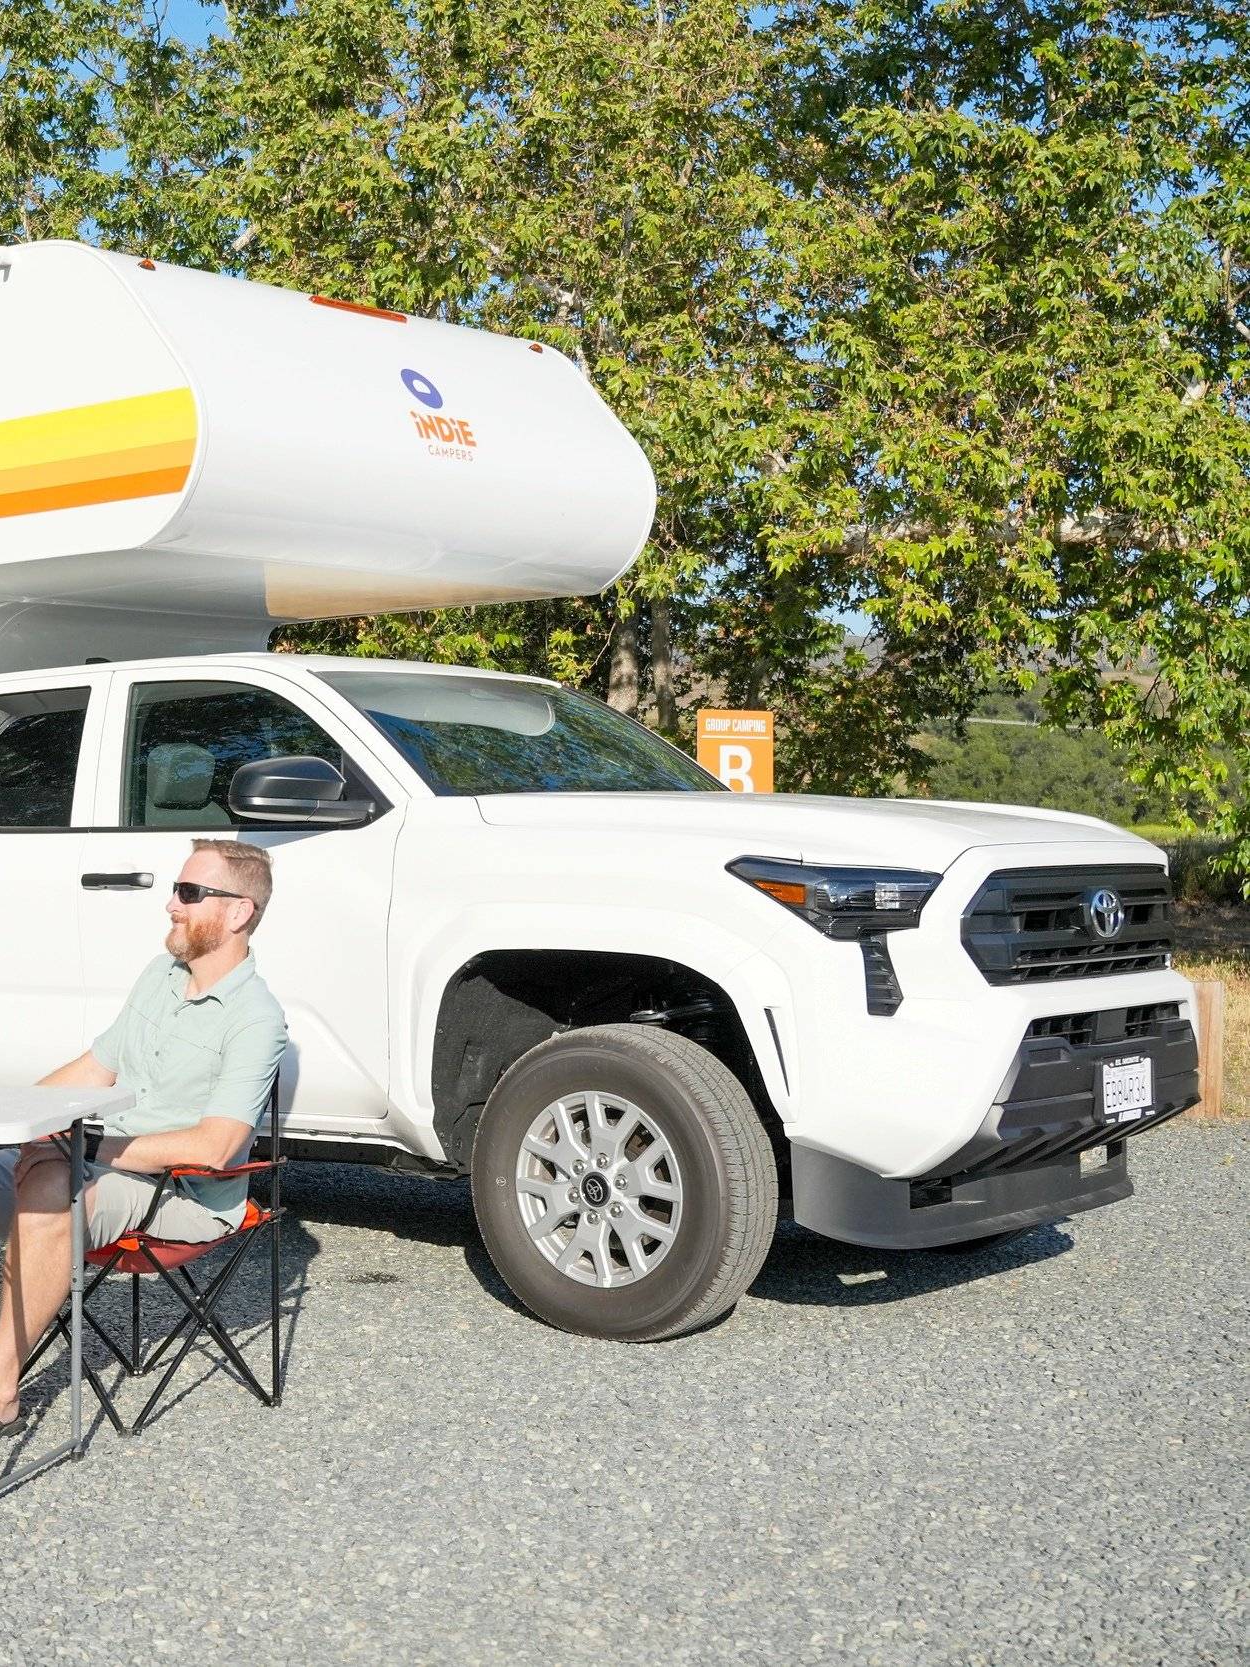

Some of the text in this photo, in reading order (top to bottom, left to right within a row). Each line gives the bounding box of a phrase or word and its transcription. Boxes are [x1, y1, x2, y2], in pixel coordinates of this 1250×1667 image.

[428, 445, 473, 462] CAMPERS
[705, 718, 766, 733] GROUP CAMPING
